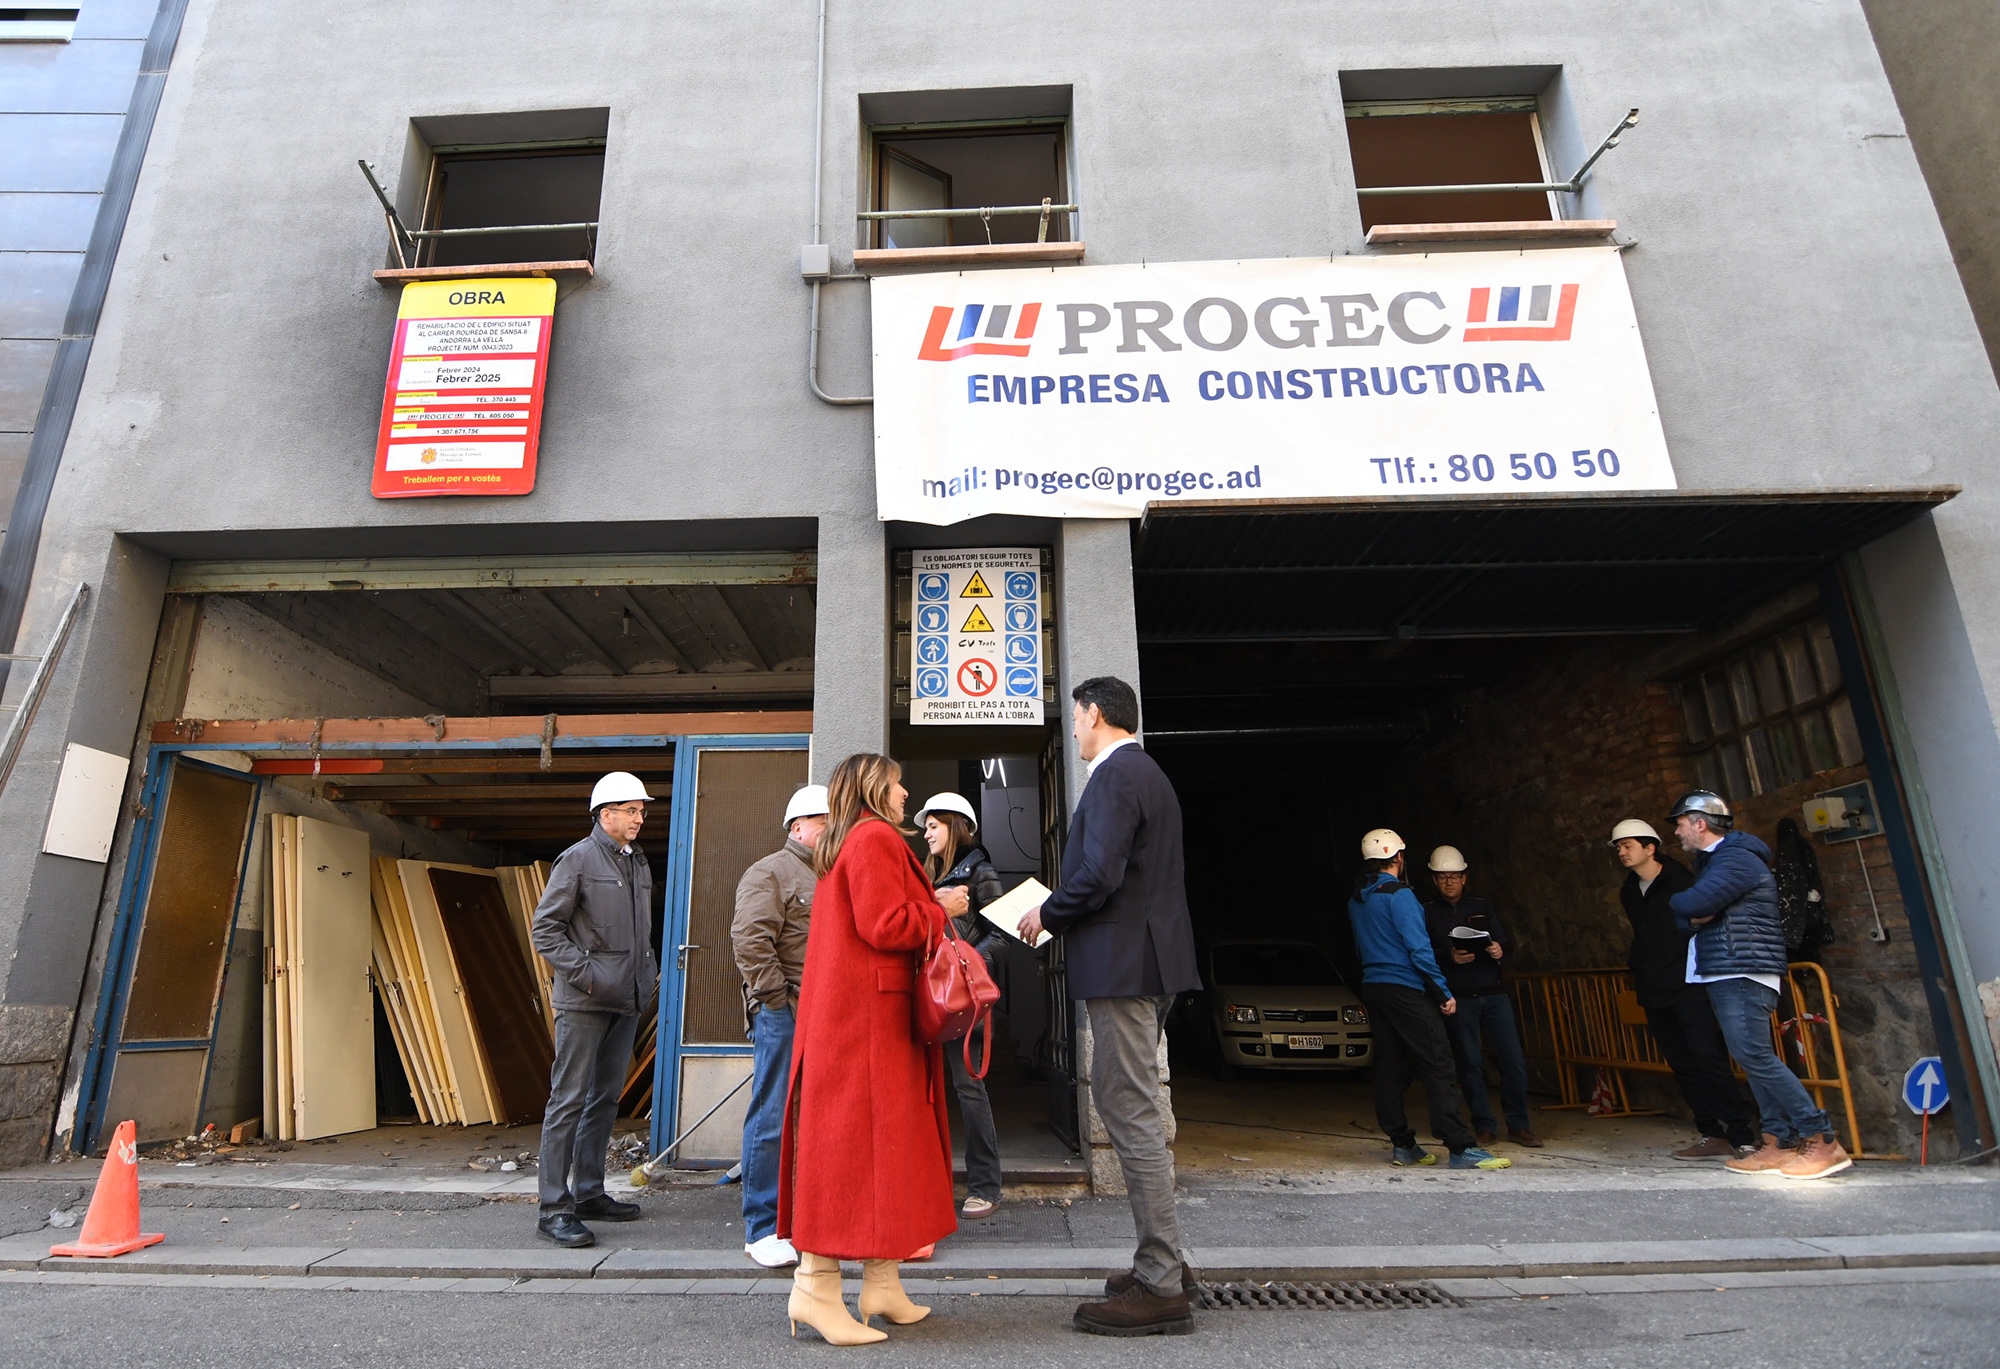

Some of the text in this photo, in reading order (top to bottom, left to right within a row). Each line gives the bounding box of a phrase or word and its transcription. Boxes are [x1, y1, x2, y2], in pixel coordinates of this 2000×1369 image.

[448, 291, 506, 305] OBRA
[1056, 291, 1451, 355] PROGEC
[436, 374, 471, 383] Febrer
[475, 374, 501, 383] 2025
[967, 362, 1545, 405] EMPRESA CONSTRUCTORA
[1370, 448, 1620, 484] Tlf.: 80 50 50
[403, 475, 445, 484] Treballem
[446, 475, 462, 484] per
[922, 464, 1262, 498] mail: progec@progec.ad
[934, 554, 978, 562] OBLIGATORI
[941, 562, 972, 570] NORMES
[958, 639, 975, 647] CV
[928, 701, 966, 709] PROHIBIT
[968, 701, 978, 709] EL
[964, 711, 995, 719] ALIENA
[997, 711, 1004, 719] A
[1005, 711, 1035, 719] L'OBRA
